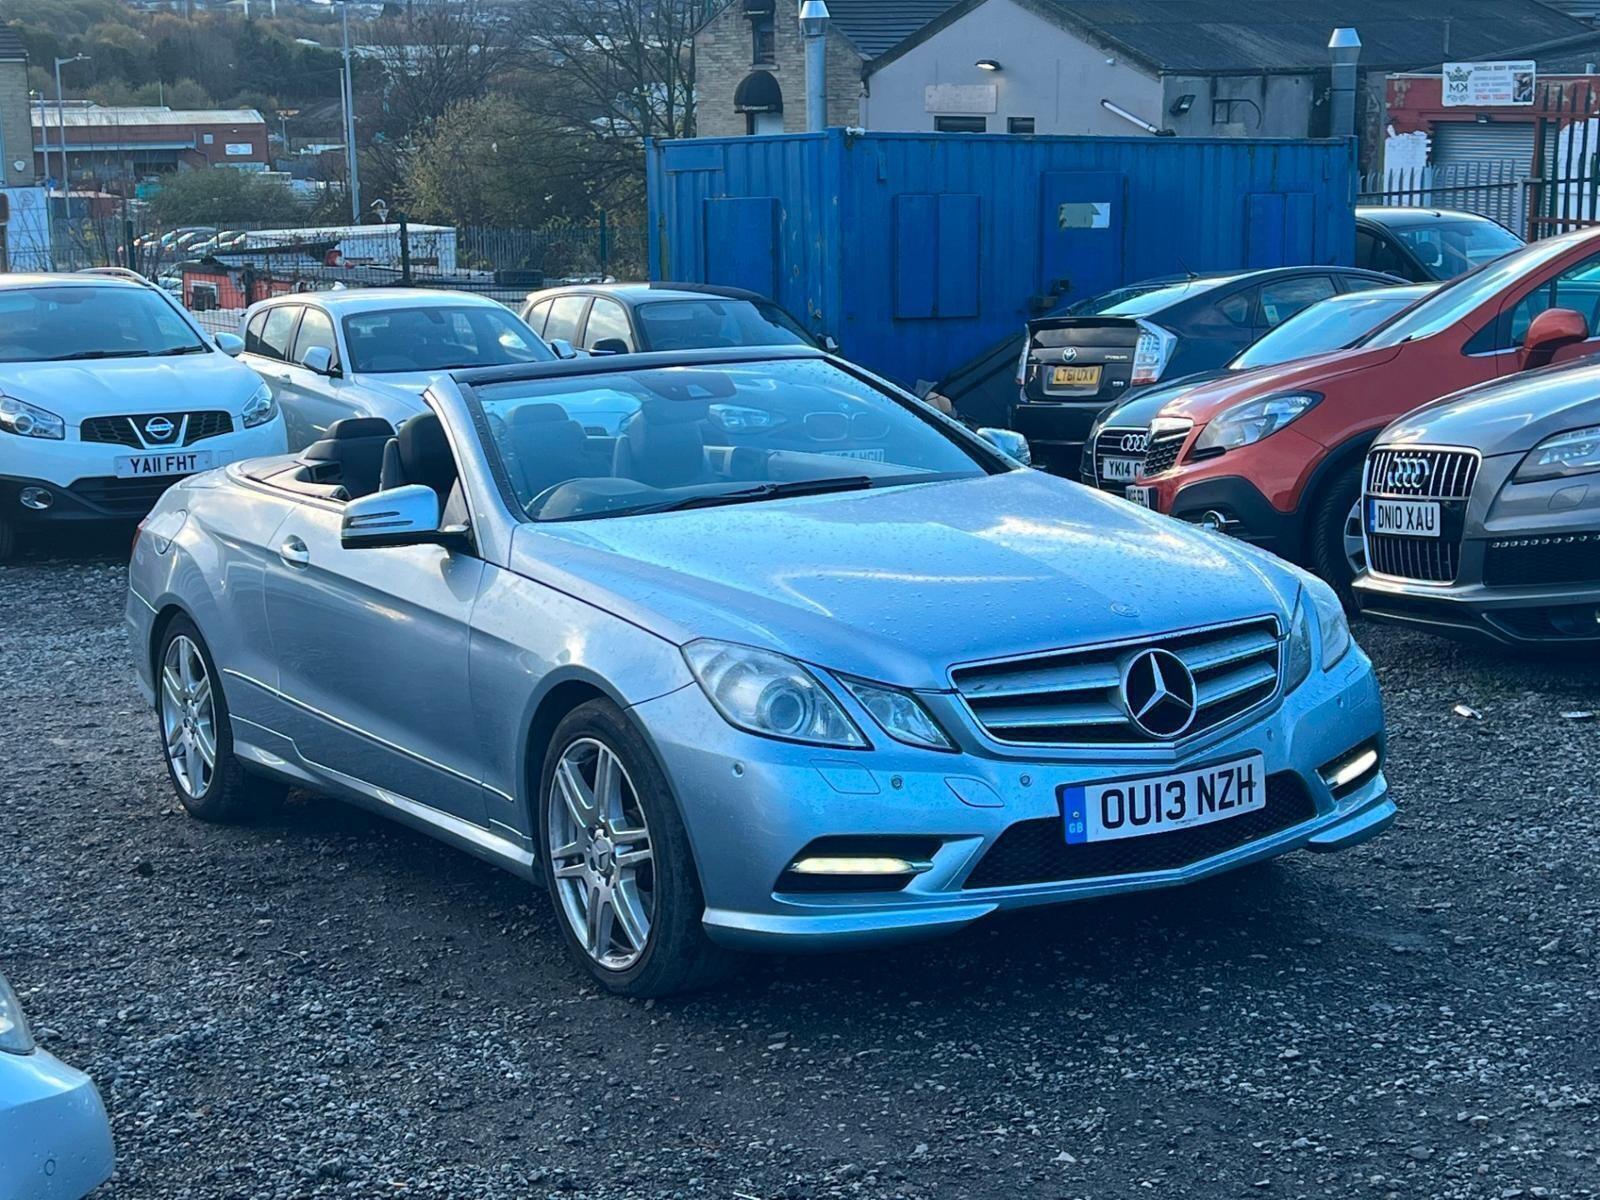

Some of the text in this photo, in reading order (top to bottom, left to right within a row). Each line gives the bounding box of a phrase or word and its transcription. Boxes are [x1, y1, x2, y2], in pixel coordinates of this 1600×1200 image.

[130, 454, 197, 474] YA11 FHT
[1109, 461, 1131, 477] YK14
[1378, 504, 1434, 531] DN10 XAU
[1101, 763, 1254, 830] OU13 NZH
[1068, 822, 1084, 834] GB
